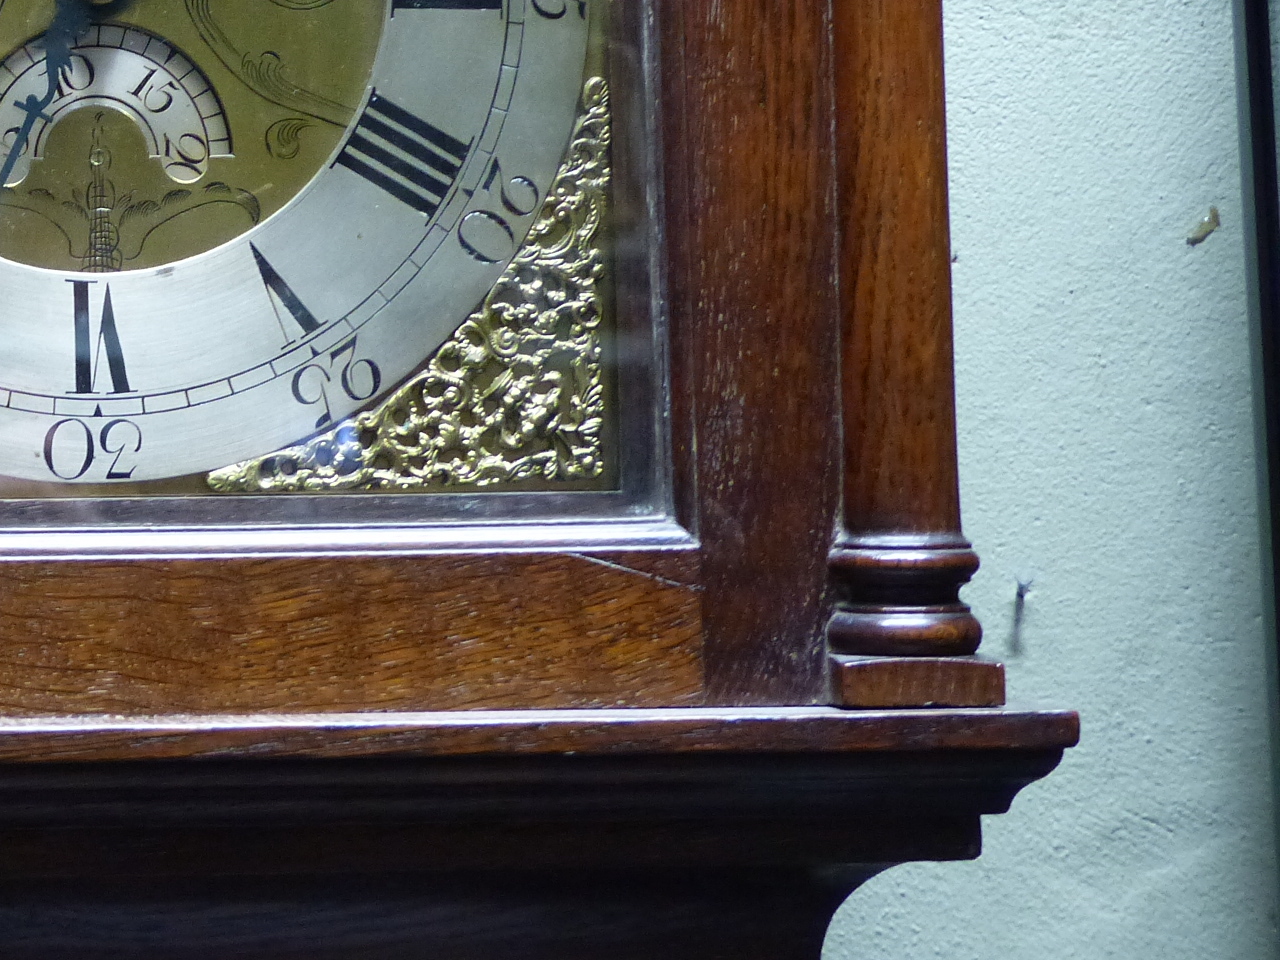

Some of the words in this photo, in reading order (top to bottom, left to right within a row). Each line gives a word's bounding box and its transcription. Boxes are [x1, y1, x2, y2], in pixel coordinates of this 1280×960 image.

[127, 65, 182, 114] 15
[164, 131, 208, 177] 20
[456, 156, 539, 265] 20
[290, 333, 382, 431] 25
[42, 417, 143, 481] 30
